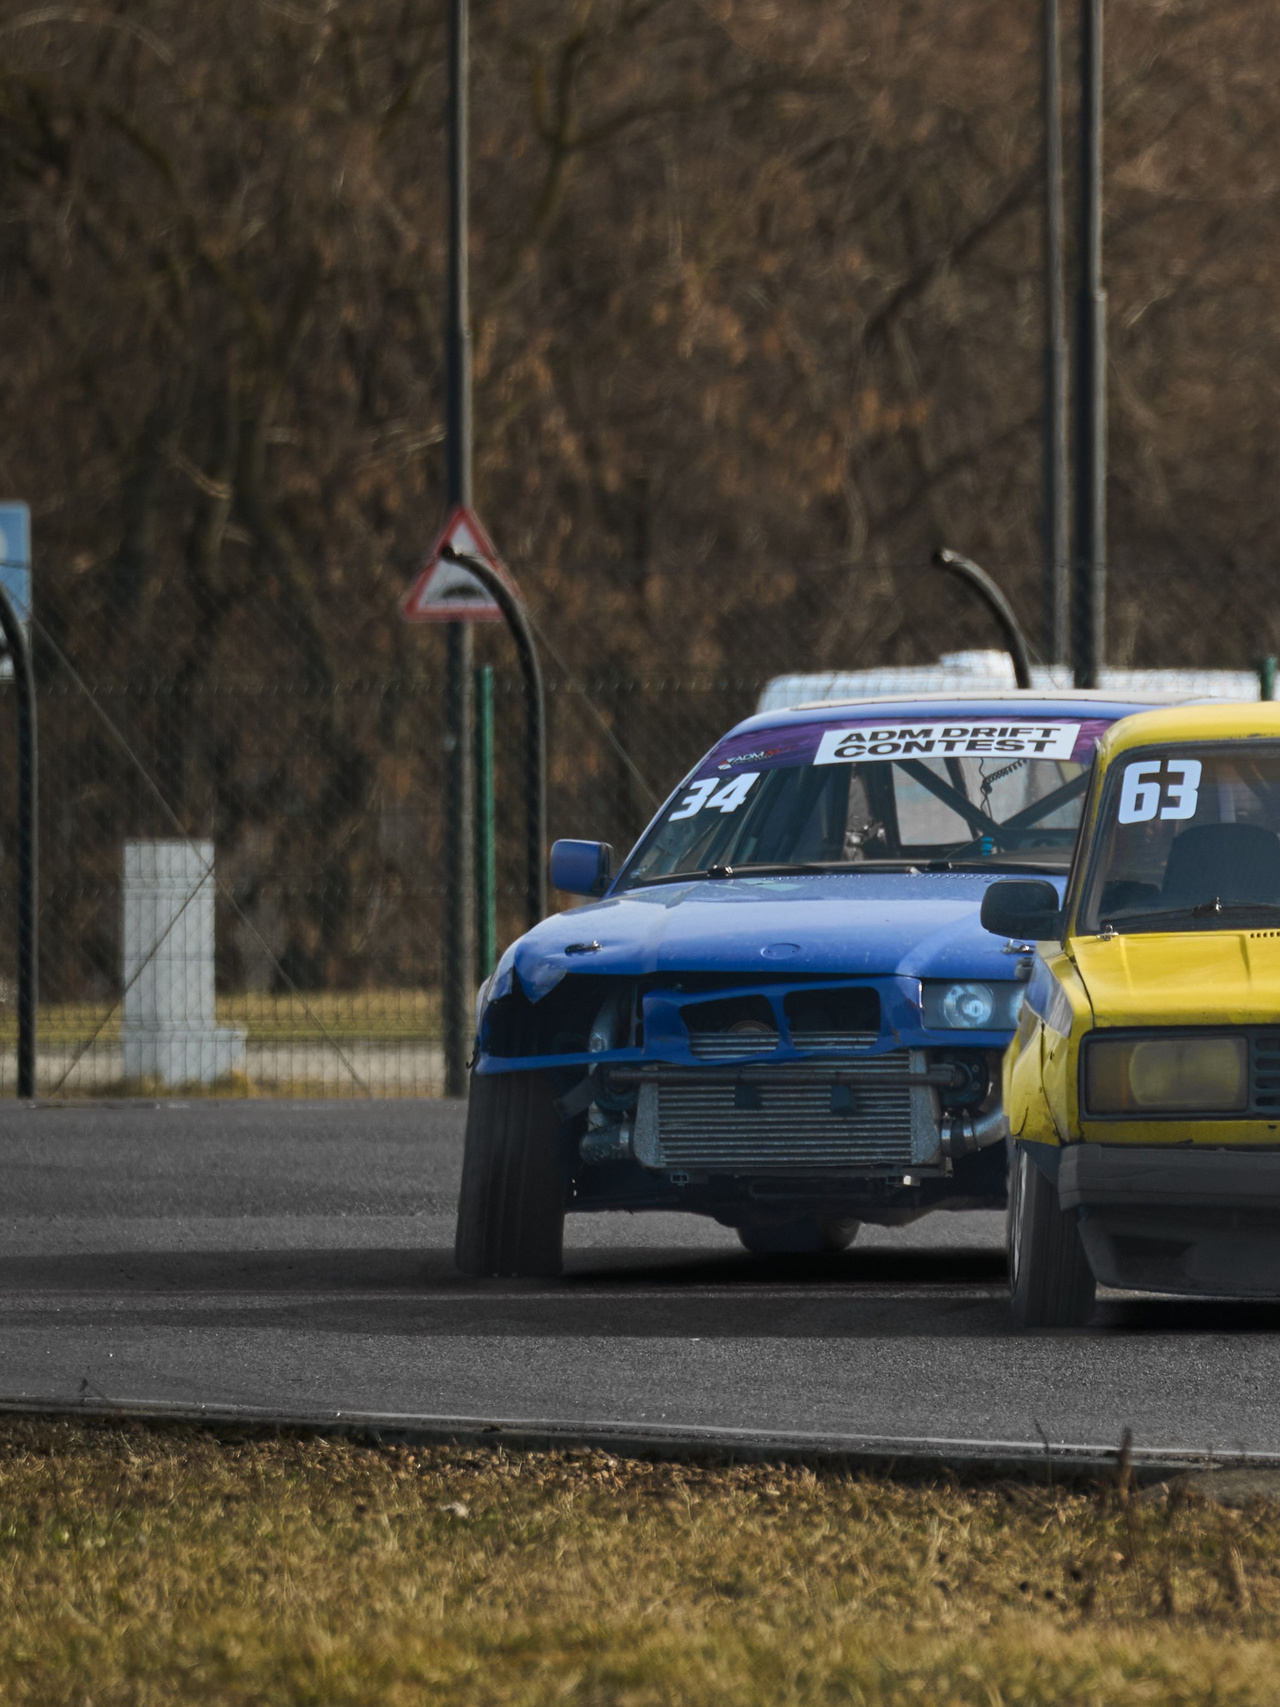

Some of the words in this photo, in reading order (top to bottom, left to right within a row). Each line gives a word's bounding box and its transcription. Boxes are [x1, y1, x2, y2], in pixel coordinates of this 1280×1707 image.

[832, 739, 1058, 759] CONTEST
[838, 728, 934, 745] ADM
[941, 727, 1061, 739] DRIFT
[668, 772, 761, 822] 34
[1118, 759, 1202, 825] 63
